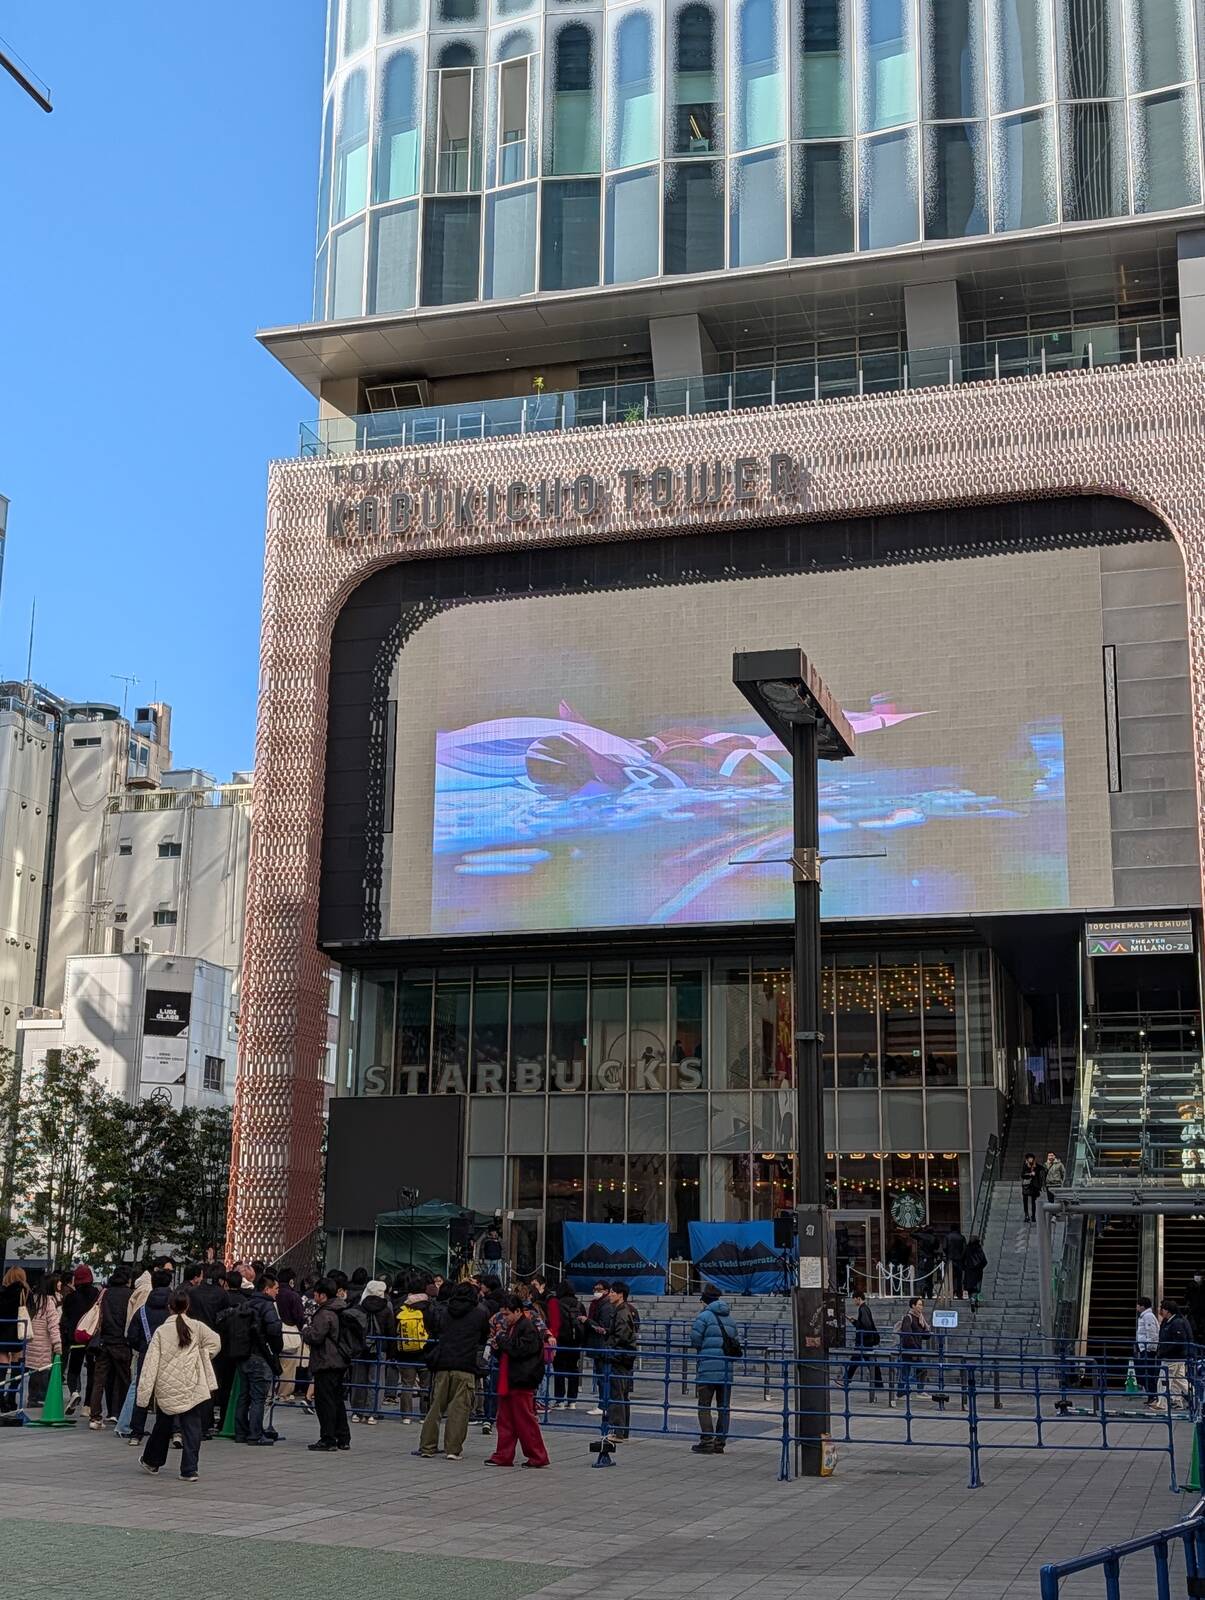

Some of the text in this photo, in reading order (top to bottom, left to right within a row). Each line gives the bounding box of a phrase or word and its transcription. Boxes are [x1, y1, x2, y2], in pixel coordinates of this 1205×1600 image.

[329, 456, 431, 484] TOKYU
[326, 454, 794, 538] KABUKICHO TOWER
[1089, 920, 1188, 930] 109CINEMAS PREMIUM
[364, 1057, 703, 1095] STARBUCKS
